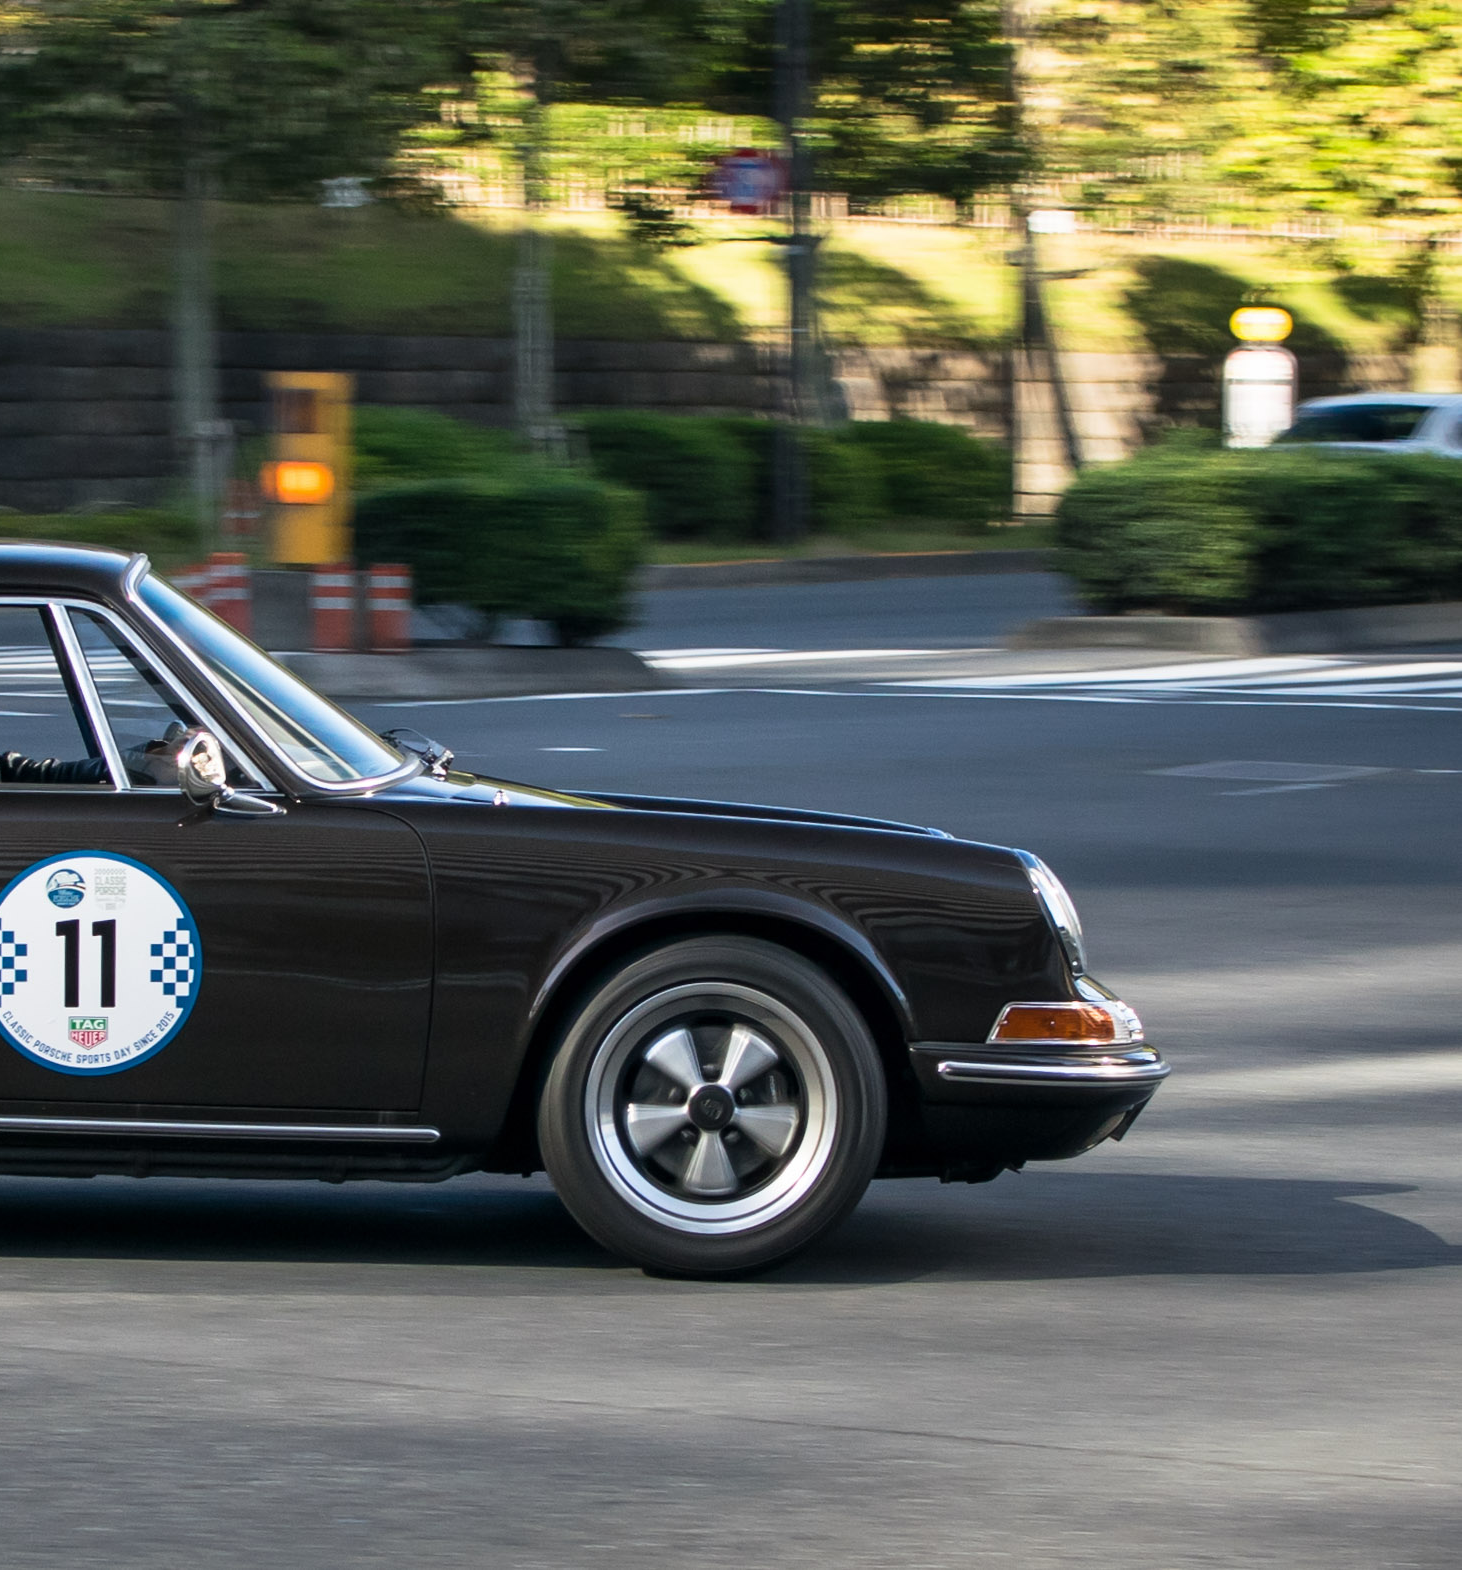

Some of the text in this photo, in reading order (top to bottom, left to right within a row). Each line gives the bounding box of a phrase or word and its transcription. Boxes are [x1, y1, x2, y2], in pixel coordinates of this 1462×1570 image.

[94, 886, 127, 896] PORSCHE
[55, 918, 116, 1008] 11
[72, 1019, 105, 1030] TAG
[2, 1010, 175, 1064] CLASSIC PORSCHE SPORTS DAY SINCE 2015
[71, 1031, 106, 1047] HEUER
